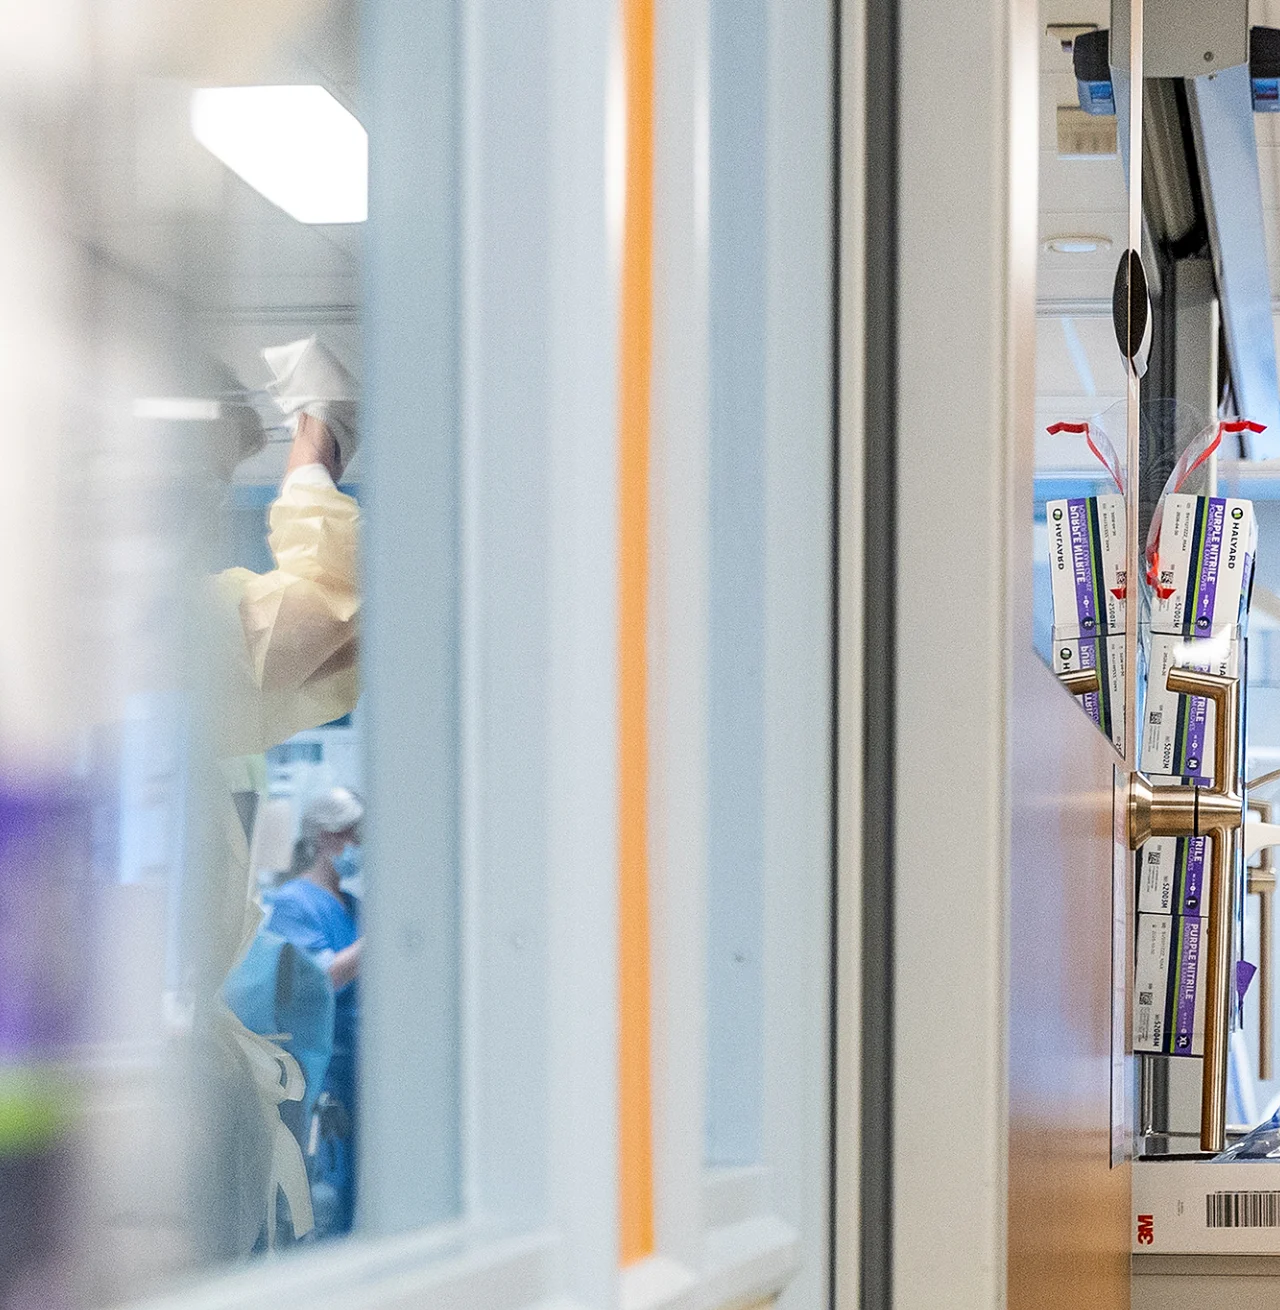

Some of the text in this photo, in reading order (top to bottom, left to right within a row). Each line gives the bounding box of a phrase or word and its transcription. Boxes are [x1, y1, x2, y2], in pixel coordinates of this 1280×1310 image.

[1206, 504, 1224, 584] PURPLE NITRILE
[1228, 522, 1240, 570] HALYARD
[1173, 602, 1182, 628] 52001M
[1195, 696, 1206, 723] TRILE
[1163, 743, 1171, 769] 52002M
[1195, 837, 1204, 862] TRILE
[1185, 923, 1199, 1000] PURPLE NITRILE
[1152, 1020, 1161, 1047] 52004M
[1179, 1036, 1188, 1047] XL
[1138, 1214, 1154, 1245] 3M
